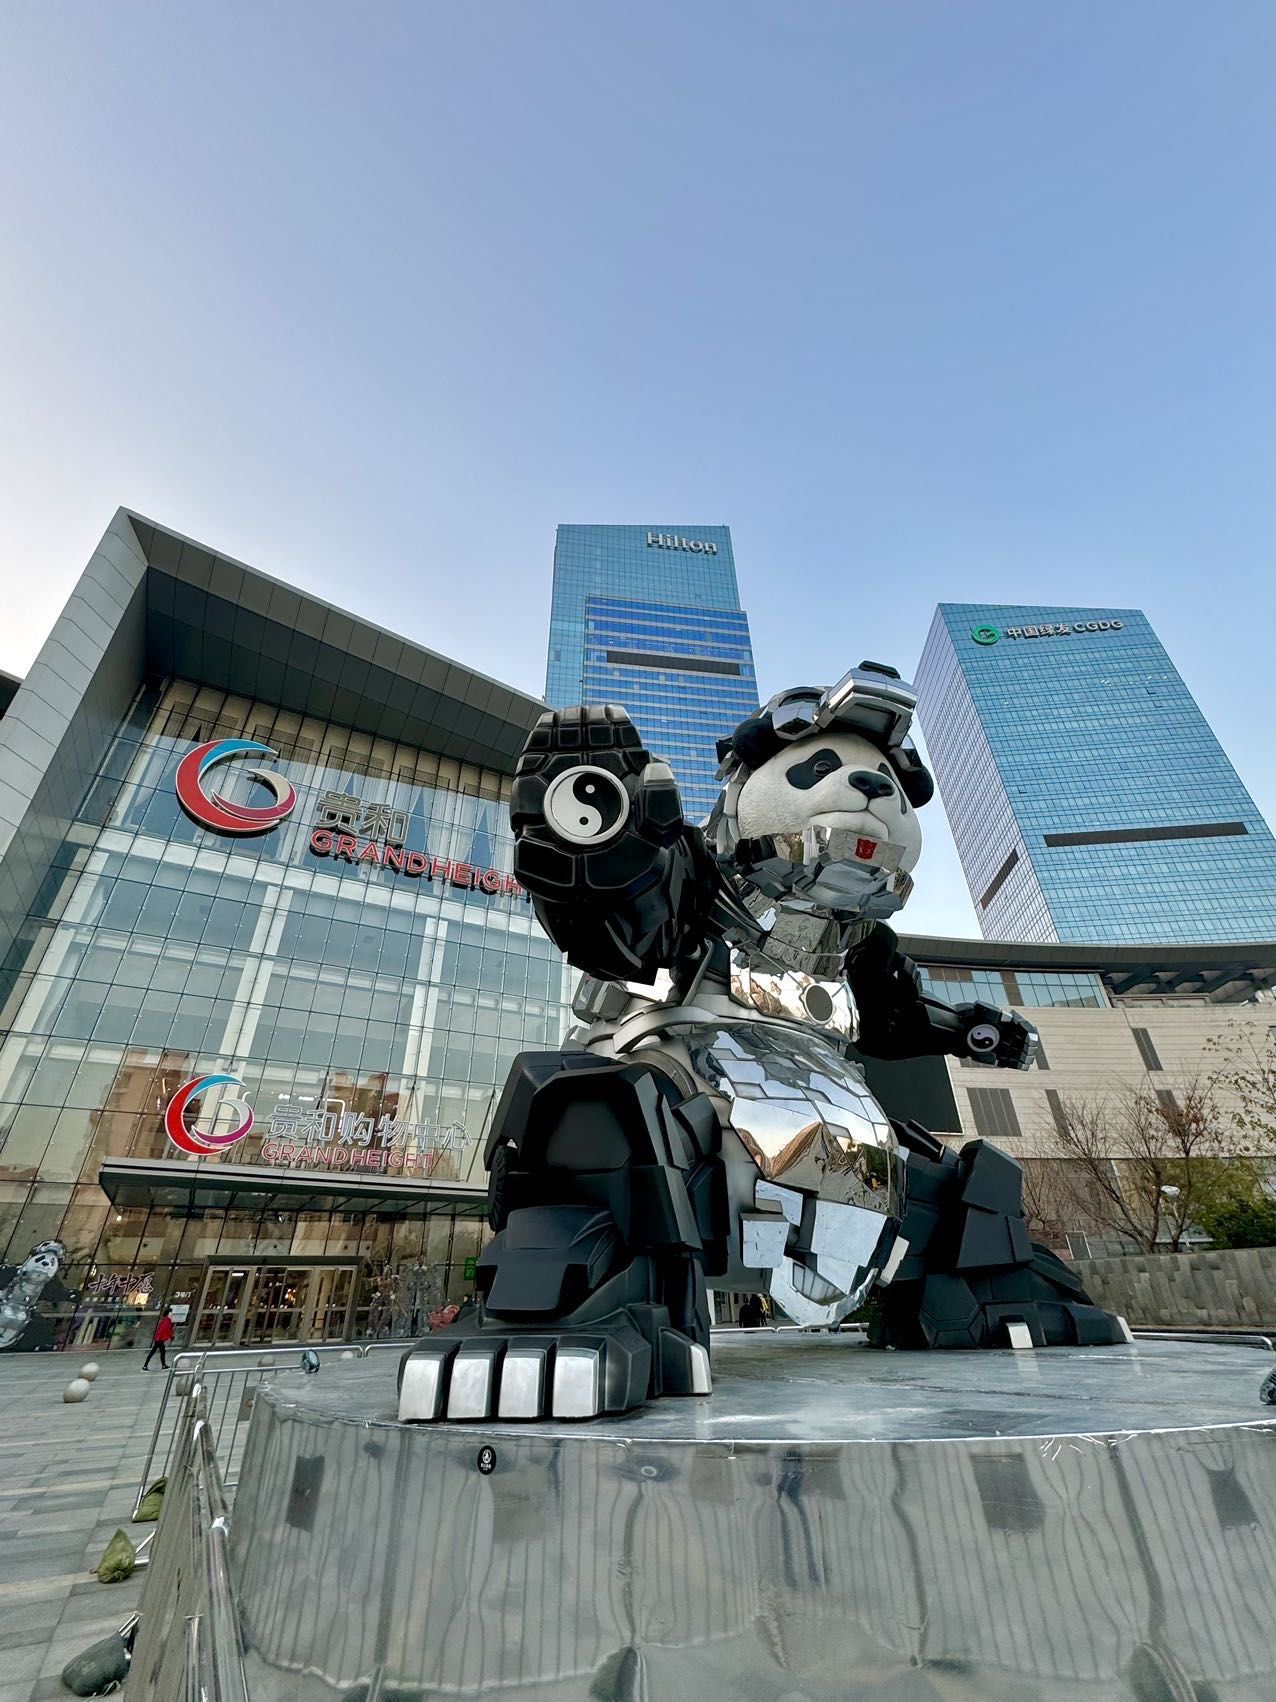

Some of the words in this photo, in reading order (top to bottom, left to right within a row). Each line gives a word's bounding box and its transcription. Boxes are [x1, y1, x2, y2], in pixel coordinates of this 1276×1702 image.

[647, 531, 718, 553] Hilton
[1074, 619, 1124, 633] CGDG
[315, 790, 409, 844] 贵和
[310, 829, 524, 894] GRANDHEIGH
[266, 1104, 474, 1151] 贵和购物中心
[260, 1142, 434, 1169] GRANDHEIGHT
